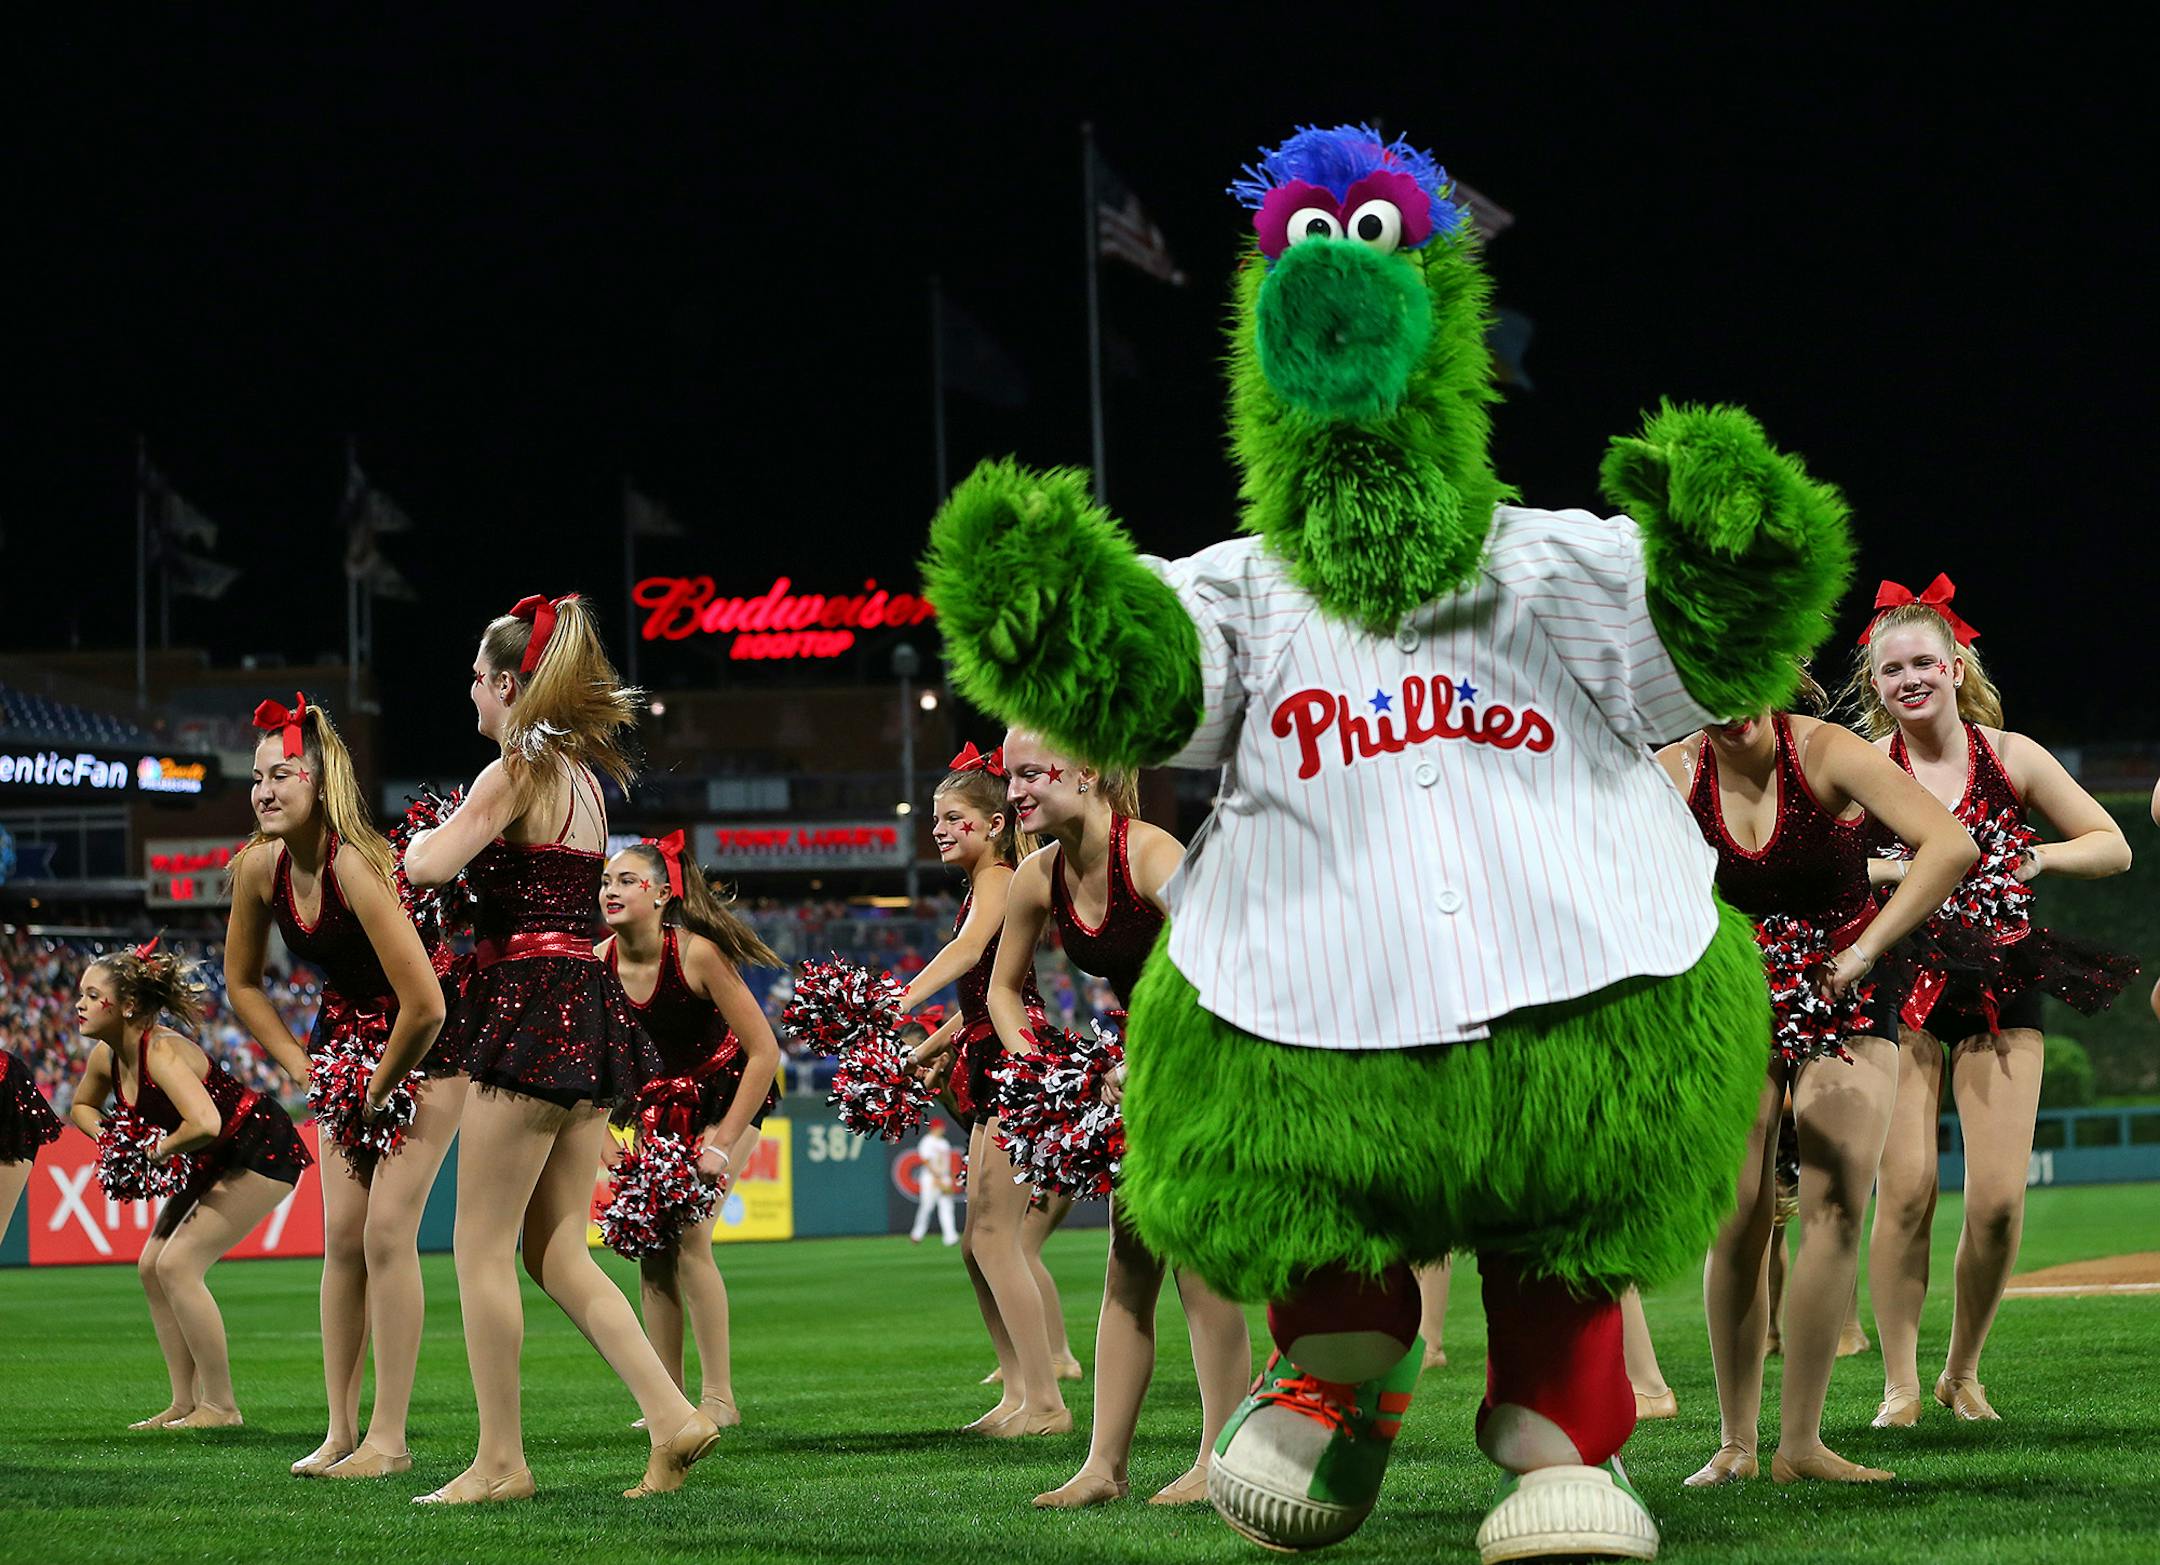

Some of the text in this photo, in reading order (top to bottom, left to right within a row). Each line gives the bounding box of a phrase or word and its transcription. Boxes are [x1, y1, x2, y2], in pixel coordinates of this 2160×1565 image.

[631, 576, 937, 640] Budweiser
[1271, 675, 1554, 779] Phillies
[0, 752, 128, 789] enticFan
